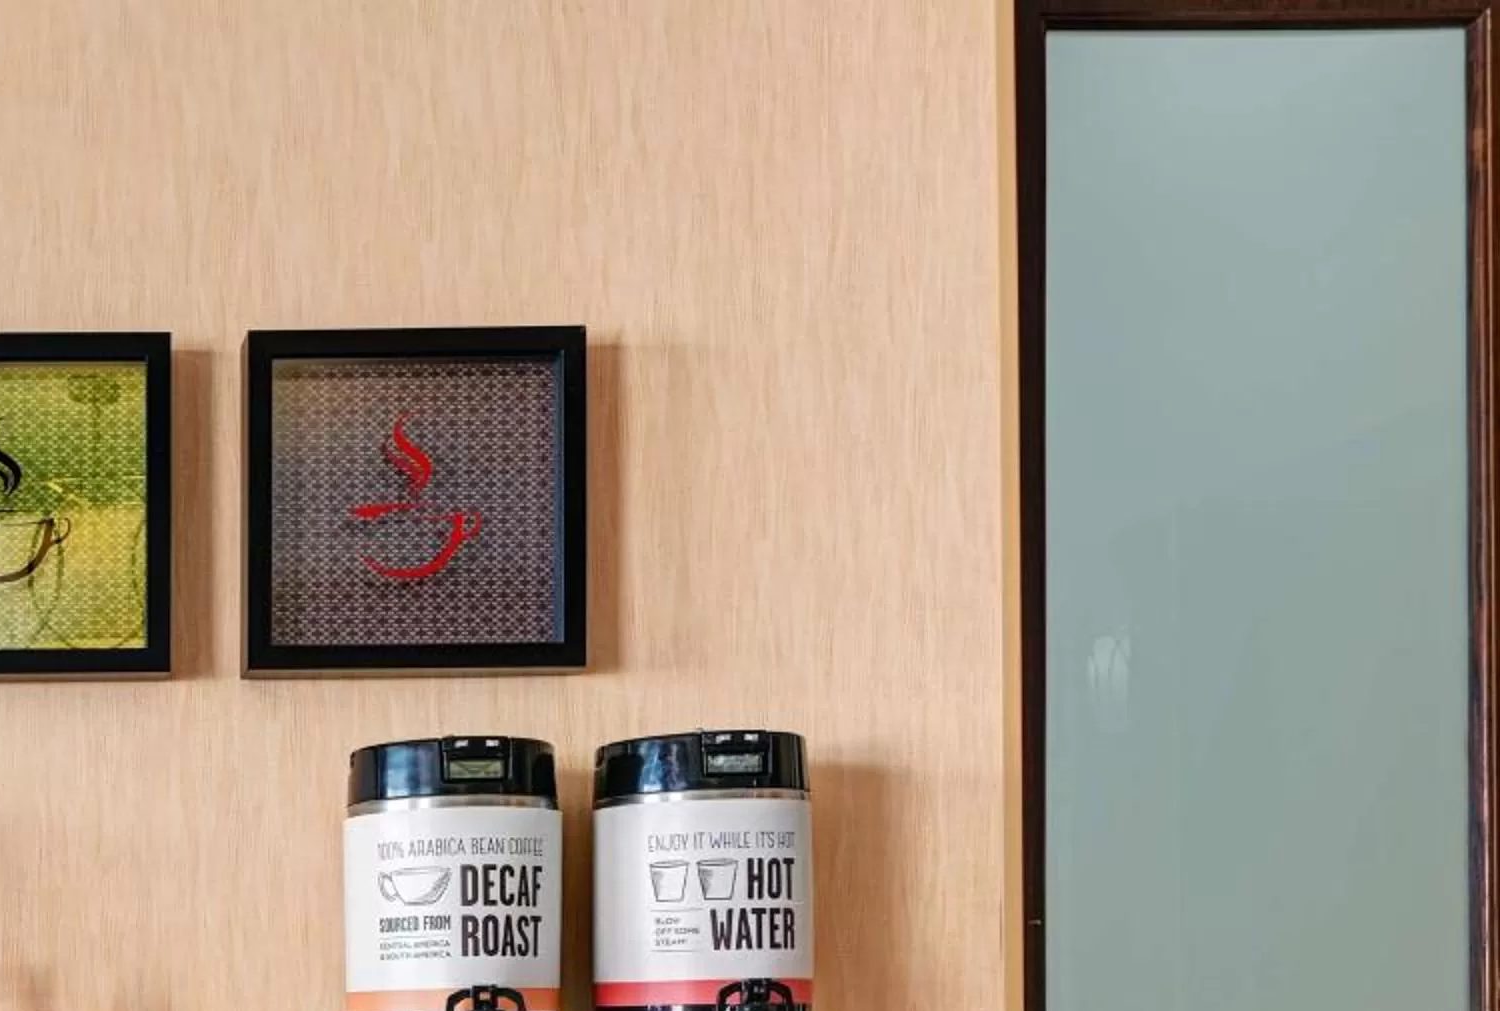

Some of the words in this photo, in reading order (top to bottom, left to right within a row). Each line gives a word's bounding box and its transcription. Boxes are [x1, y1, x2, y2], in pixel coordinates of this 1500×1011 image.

[408, 836, 467, 857] ARABICA
[471, 836, 506, 855] BEAN
[648, 831, 689, 852] ENJOY
[693, 831, 706, 849] IT
[708, 831, 751, 849] WHILE
[459, 864, 543, 907] DECAF
[747, 857, 795, 900] HOT
[424, 914, 451, 931] FROM
[461, 914, 542, 957] ROAST
[709, 907, 795, 951] WATER
